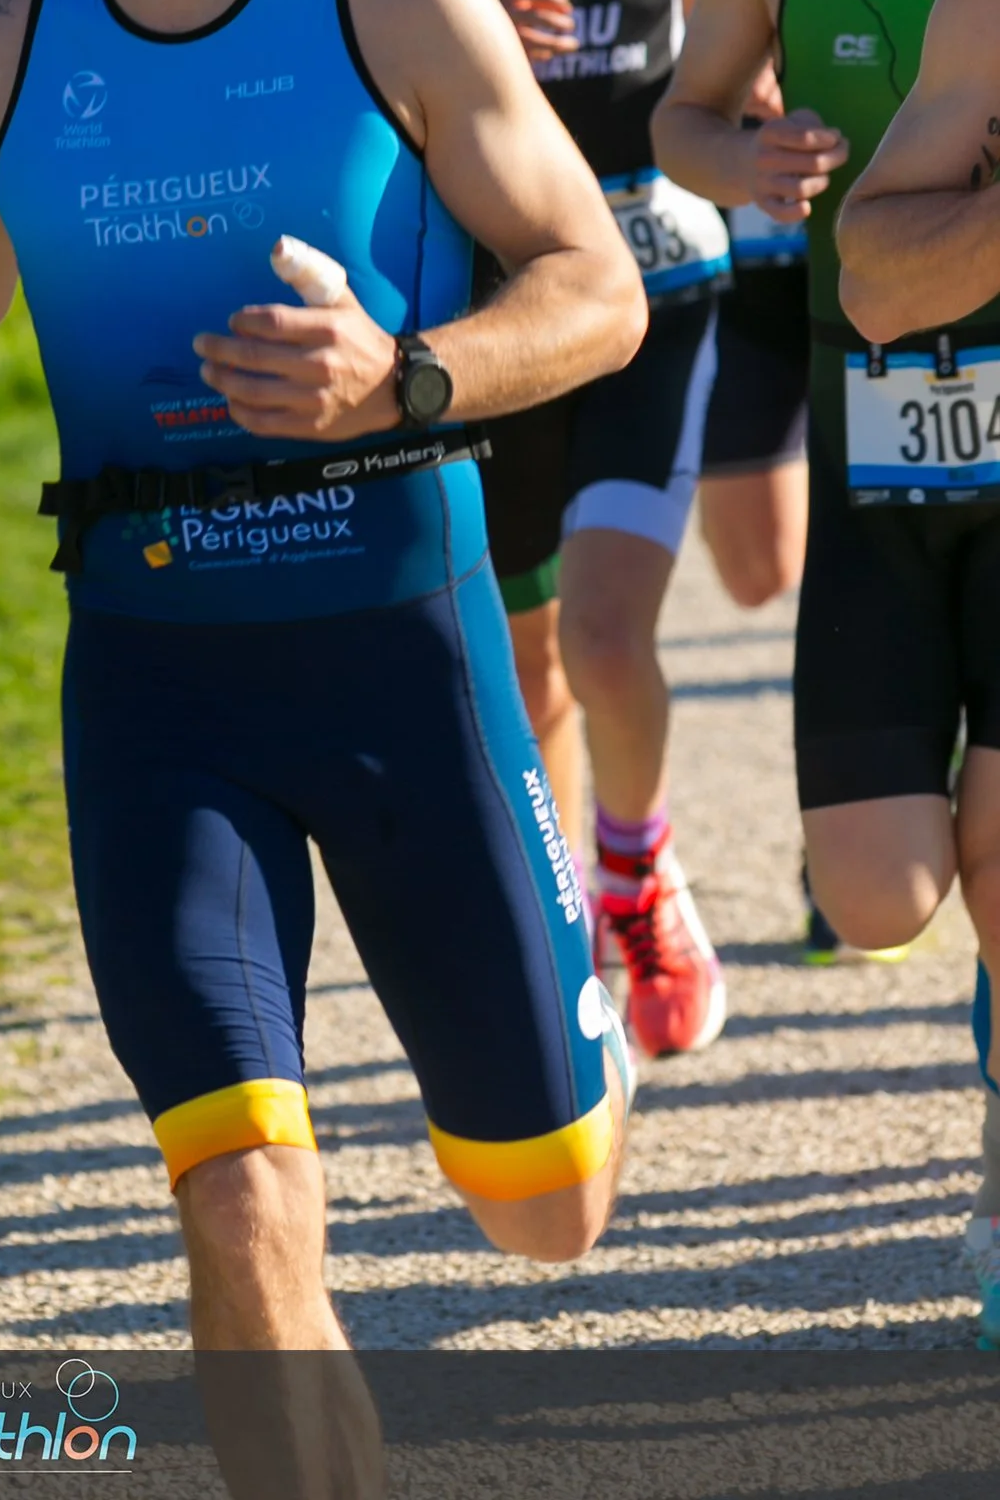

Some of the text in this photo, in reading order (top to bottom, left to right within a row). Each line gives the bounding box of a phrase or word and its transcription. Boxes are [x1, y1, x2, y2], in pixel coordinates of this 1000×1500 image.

[225, 74, 295, 100] HUUB
[54, 135, 111, 151] Triathlon
[62, 121, 103, 136] World
[80, 163, 272, 210] PÉRIGUEUX
[85, 209, 228, 248] Triathlon
[628, 212, 686, 269] 93
[153, 406, 227, 429] TRIATH
[363, 441, 446, 473] Kalenji
[182, 518, 353, 554] Périgueux
[522, 767, 580, 925] PÉRIGUEUX
